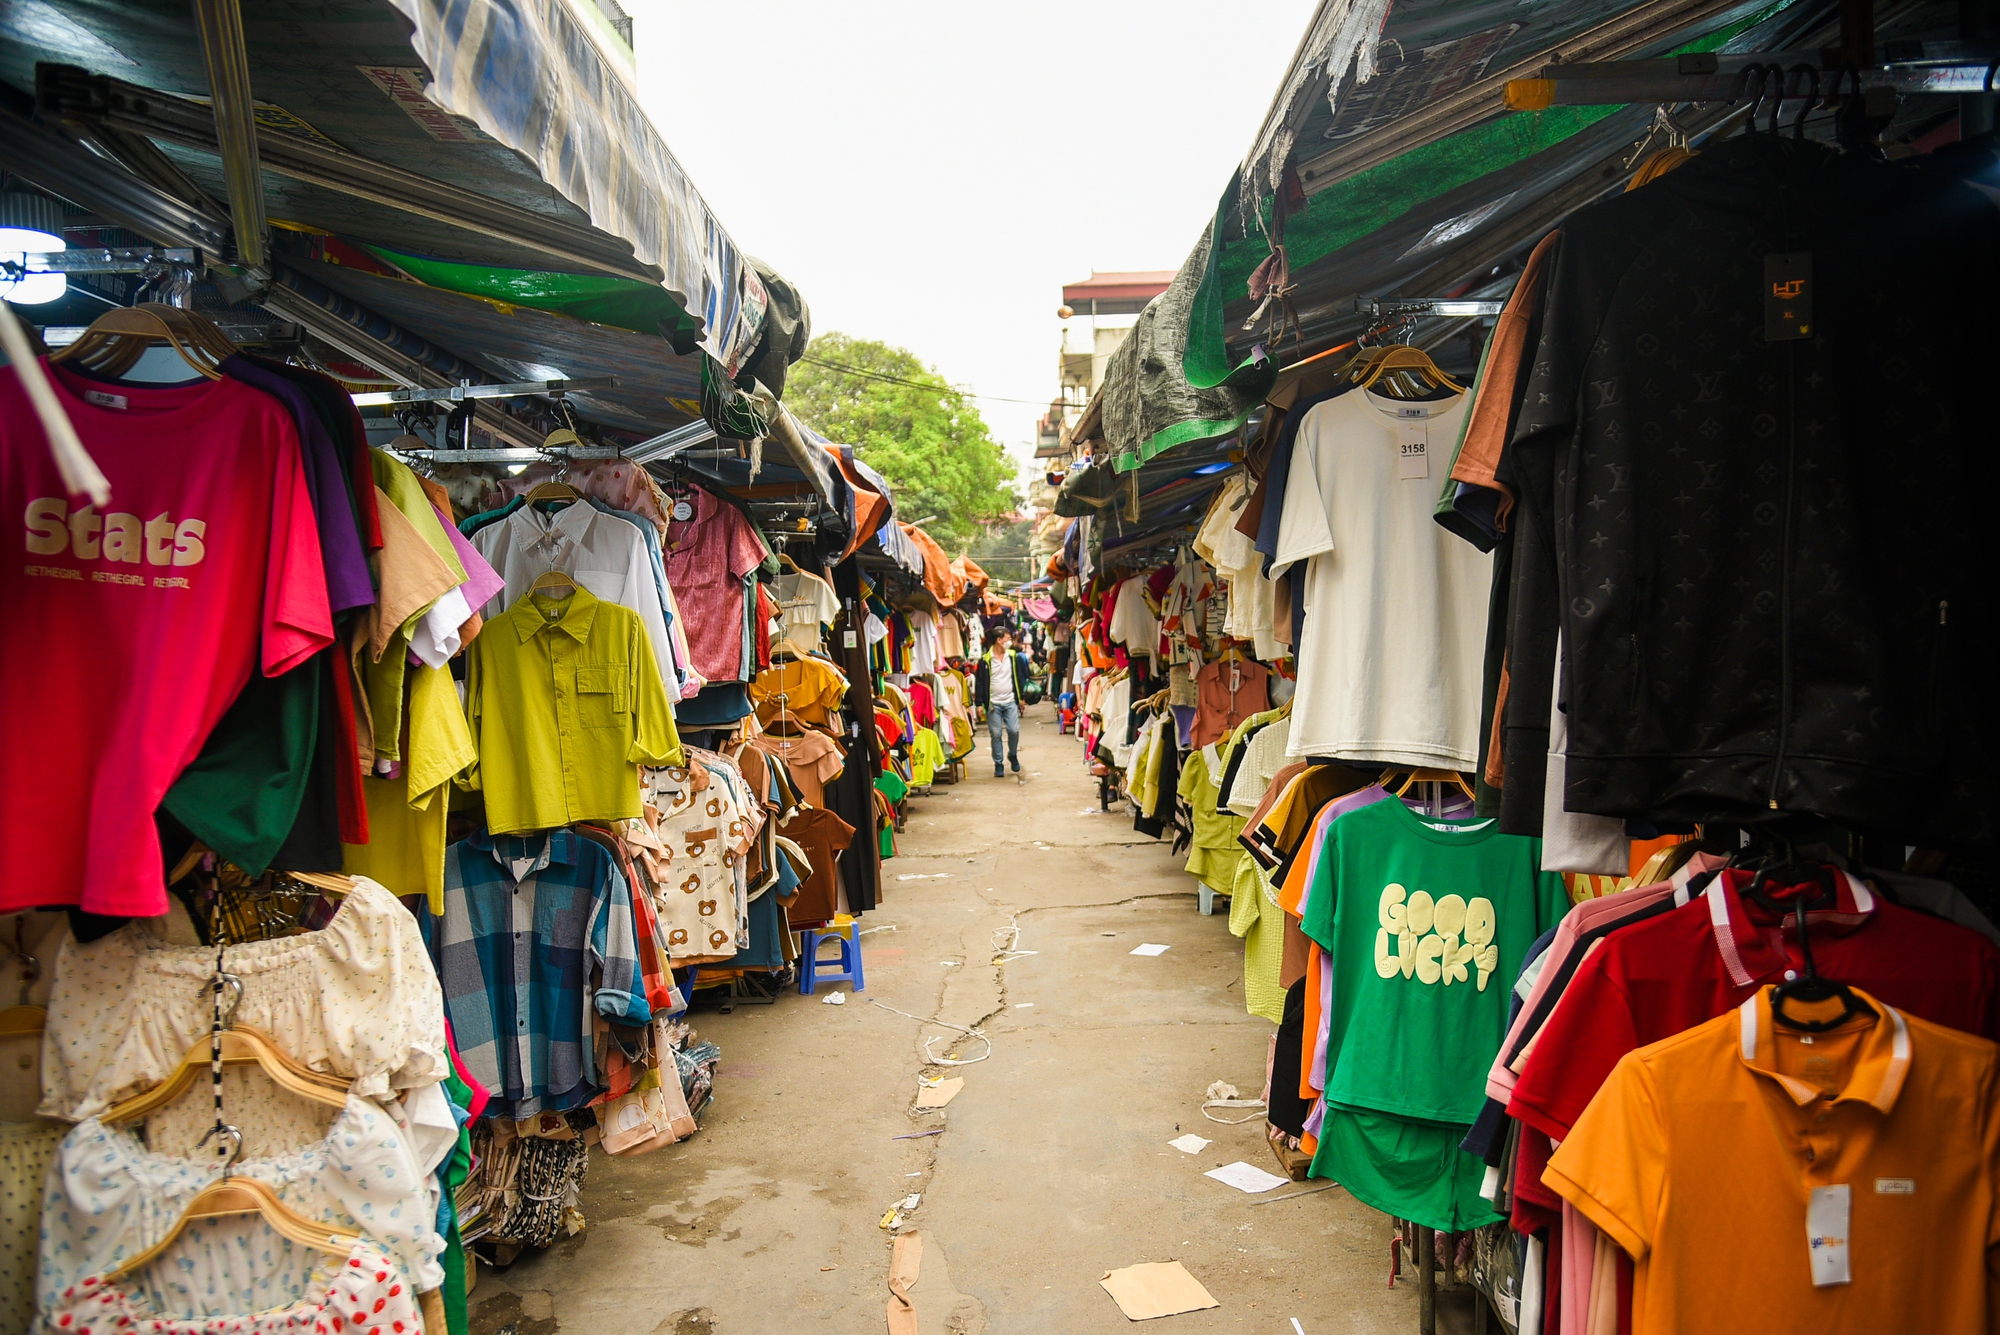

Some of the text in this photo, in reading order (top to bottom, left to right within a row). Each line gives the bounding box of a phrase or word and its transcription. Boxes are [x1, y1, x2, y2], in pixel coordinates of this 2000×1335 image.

[1773, 280, 1804, 296] HT
[1401, 443, 1425, 454] 3158
[24, 497, 206, 566] Stats
[24, 565, 85, 581] RETHEGIRL
[91, 571, 146, 586] RETHEGIRL
[1379, 883, 1496, 946] GOOD
